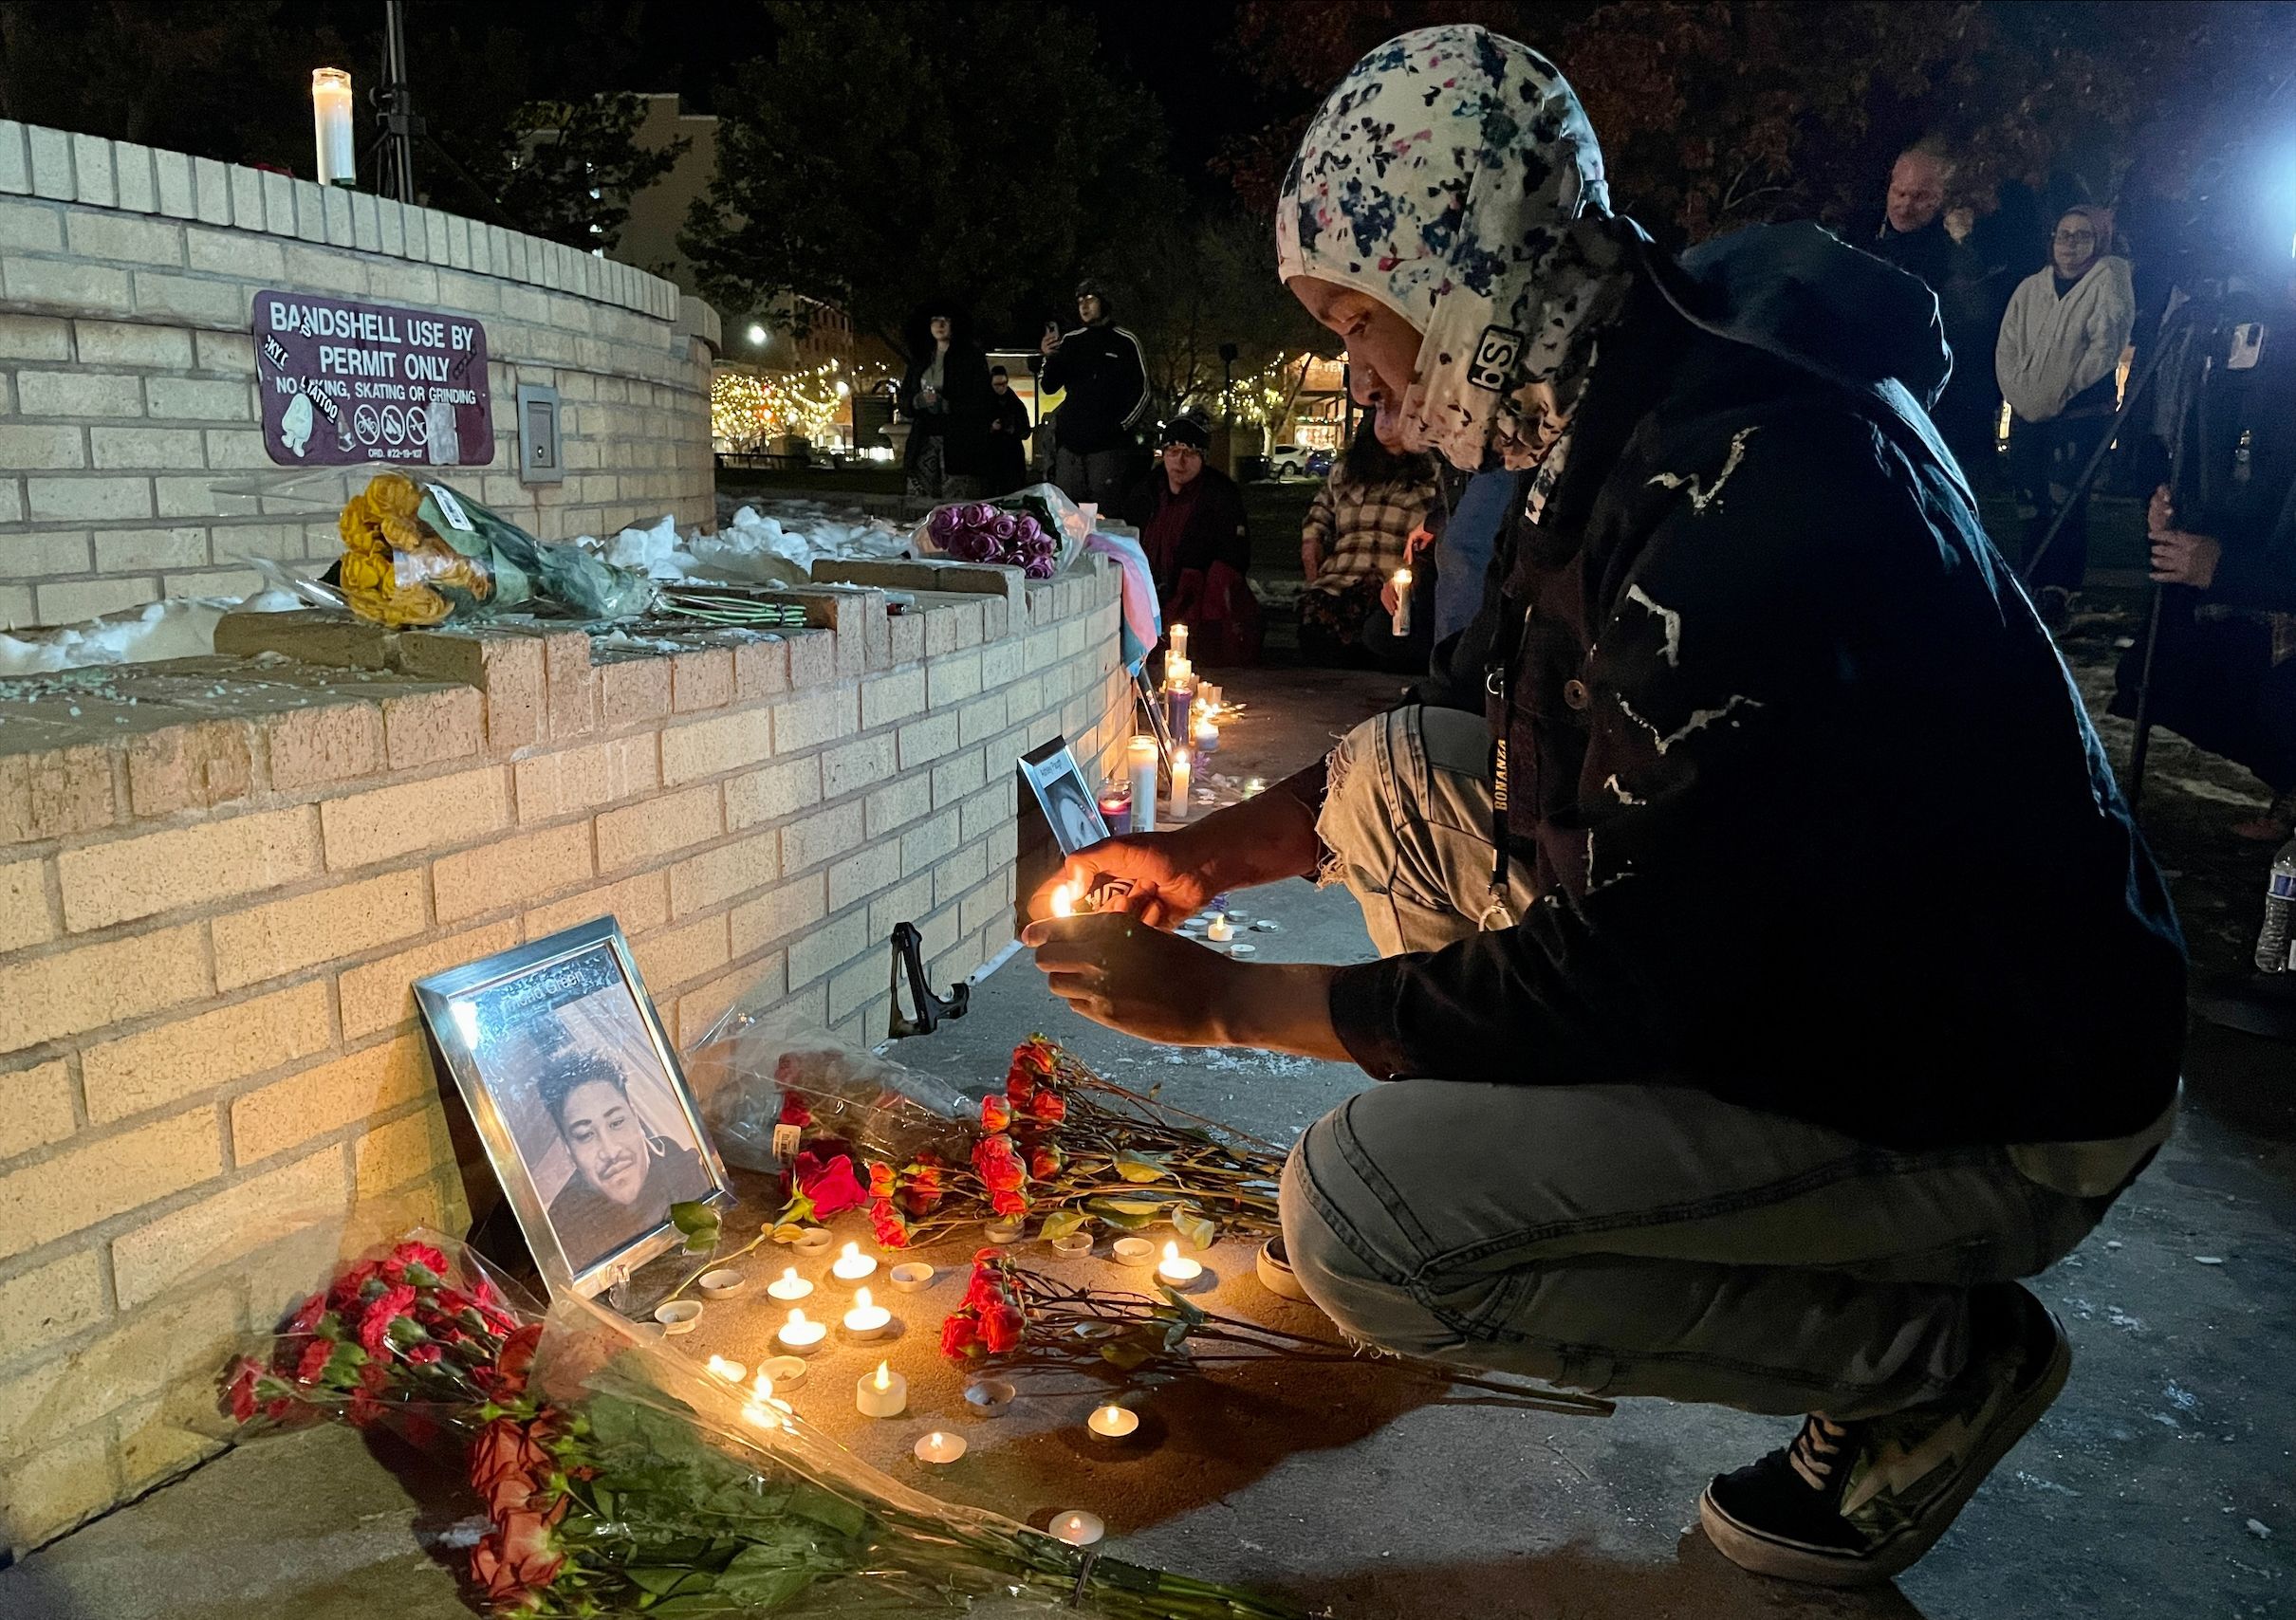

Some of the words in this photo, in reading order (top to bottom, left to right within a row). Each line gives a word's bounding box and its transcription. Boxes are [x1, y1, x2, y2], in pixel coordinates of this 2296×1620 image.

[269, 301, 402, 344] BANDSHELL
[407, 319, 446, 349] USE
[451, 324, 473, 352] BY
[319, 345, 398, 378] PERMIT
[404, 353, 450, 382] ONLY
[276, 377, 298, 395] NO
[355, 381, 406, 400] SKATING
[409, 385, 425, 401] OR
[429, 386, 476, 405] GRINDING
[306, 378, 338, 419] TATTOO
[1493, 738, 1509, 812] BONANZA
[545, 969, 585, 995] Green
